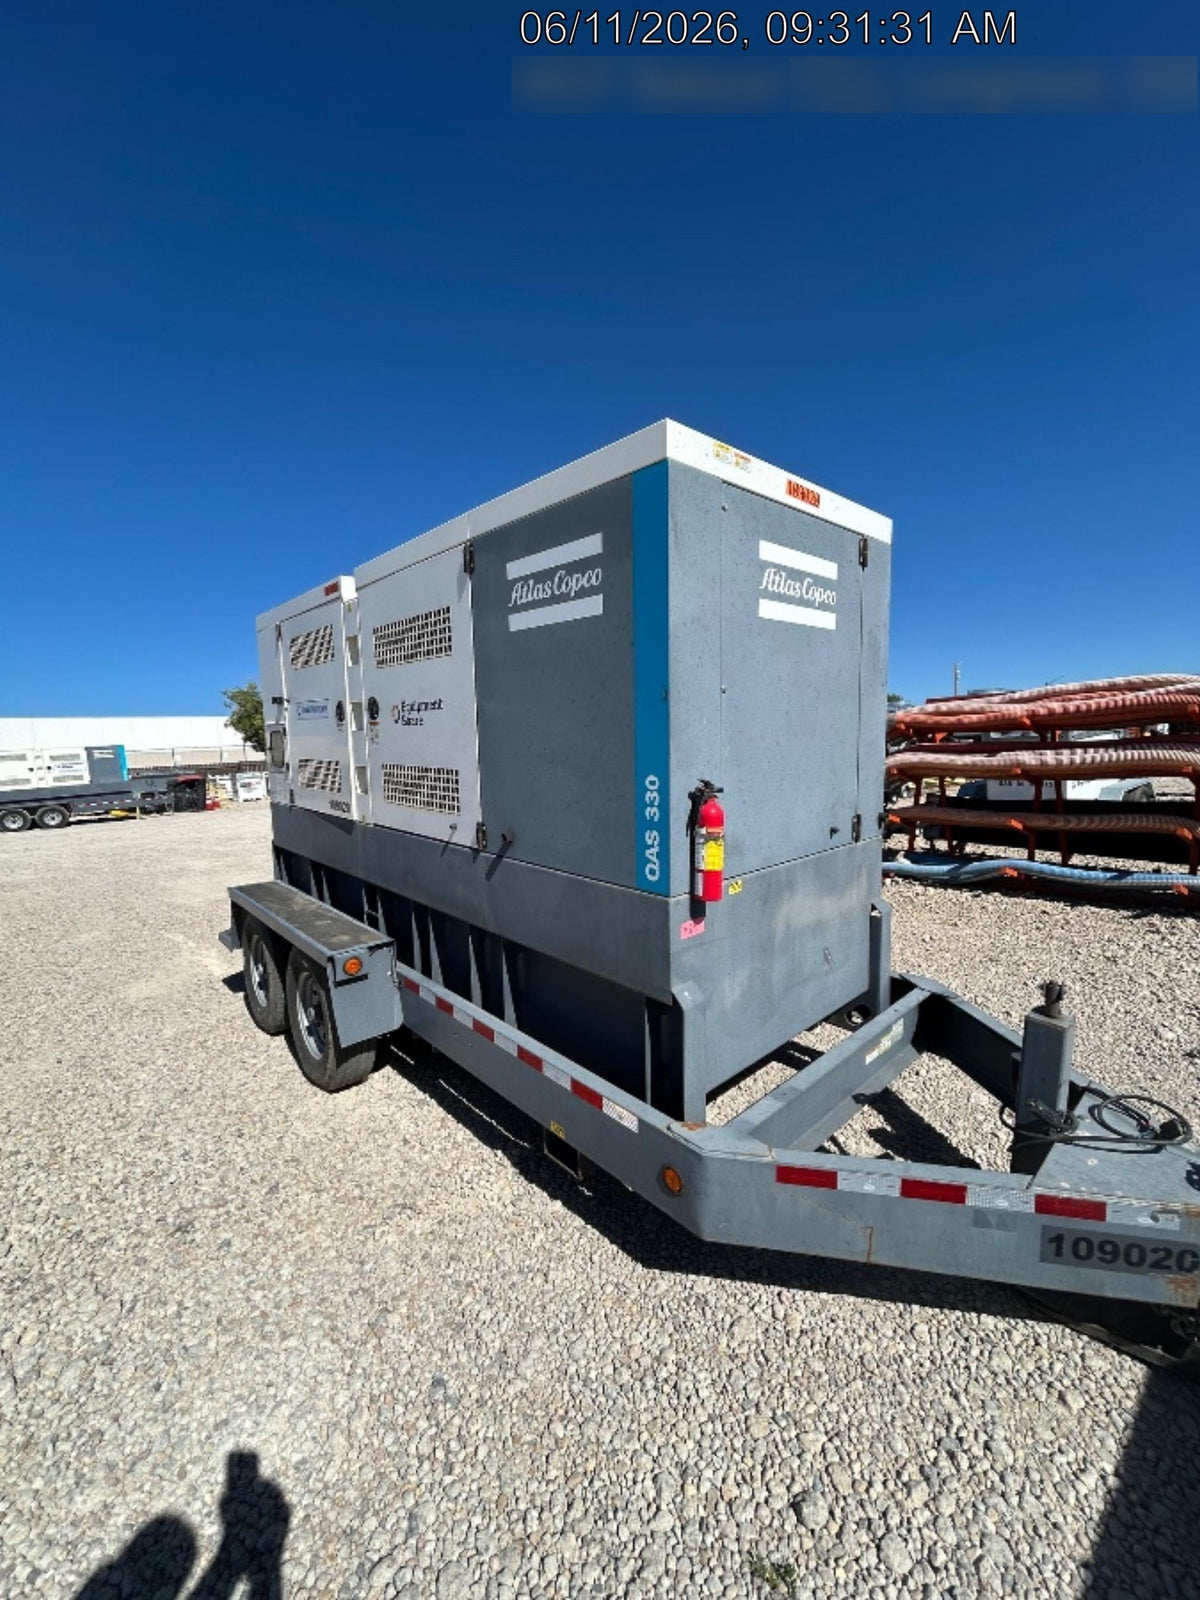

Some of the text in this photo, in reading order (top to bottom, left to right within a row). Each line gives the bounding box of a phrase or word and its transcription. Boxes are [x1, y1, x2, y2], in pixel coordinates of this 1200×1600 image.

[507, 568, 602, 607] Atlas Copco
[759, 568, 837, 607] Atlas Copco
[645, 774, 660, 822] 330
